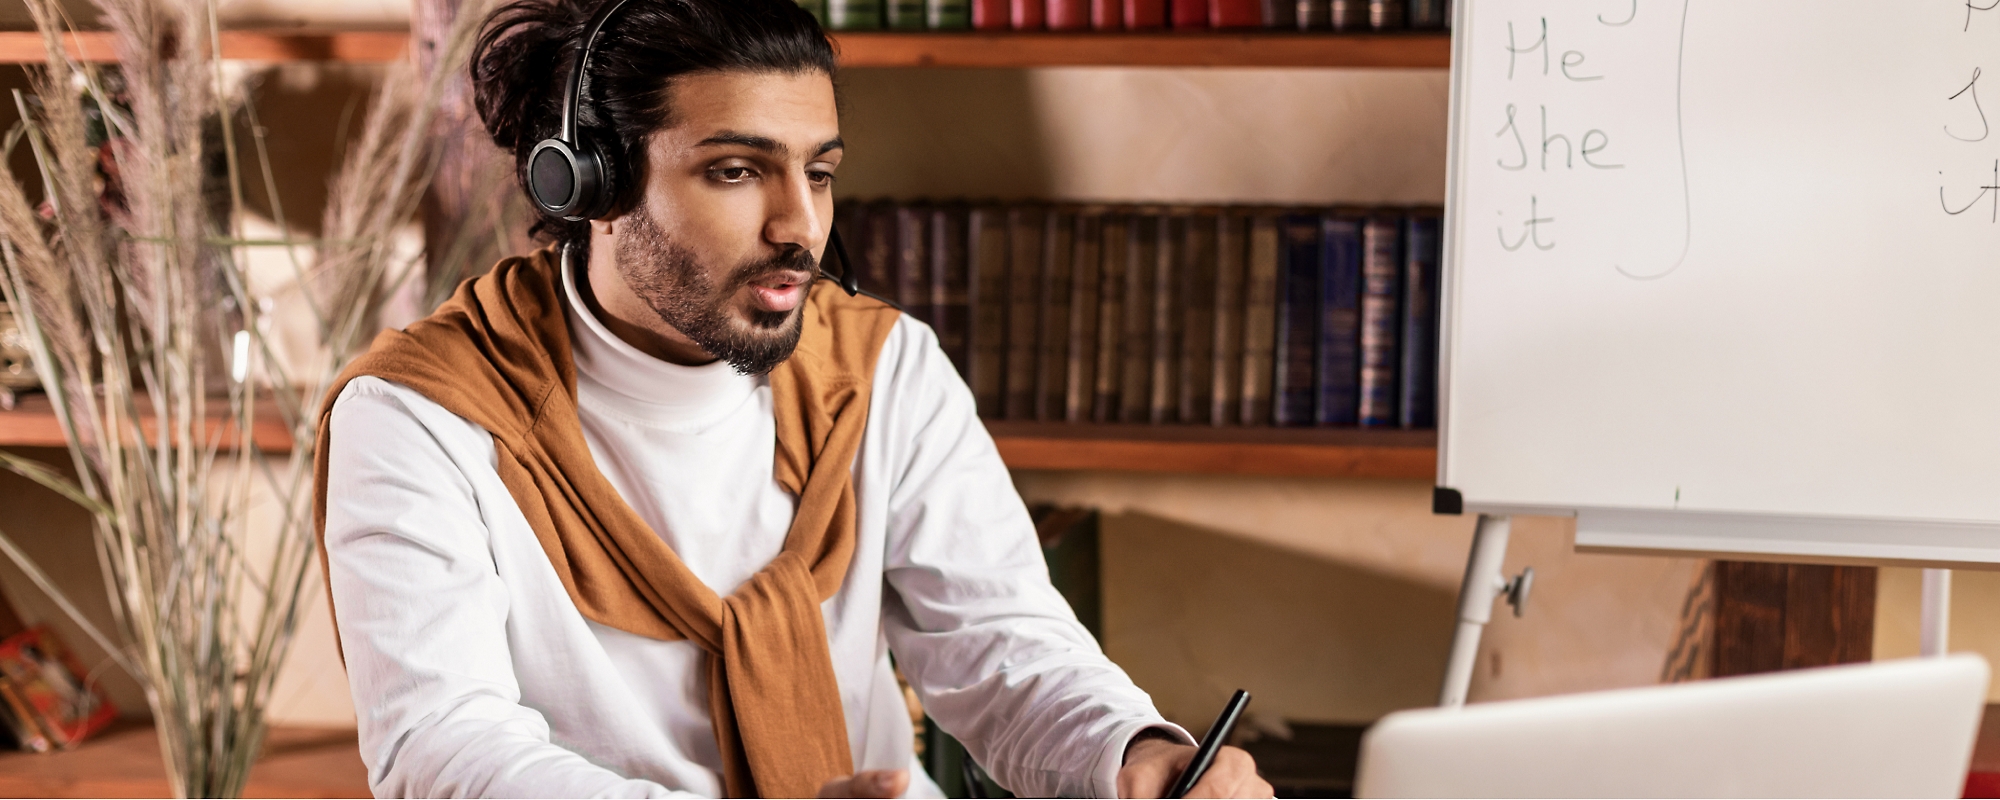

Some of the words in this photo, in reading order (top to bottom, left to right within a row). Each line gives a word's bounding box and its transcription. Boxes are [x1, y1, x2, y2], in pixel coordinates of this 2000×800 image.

[1505, 16, 1604, 81] He
[1496, 103, 1625, 171] She
[1497, 195, 1556, 252] it
